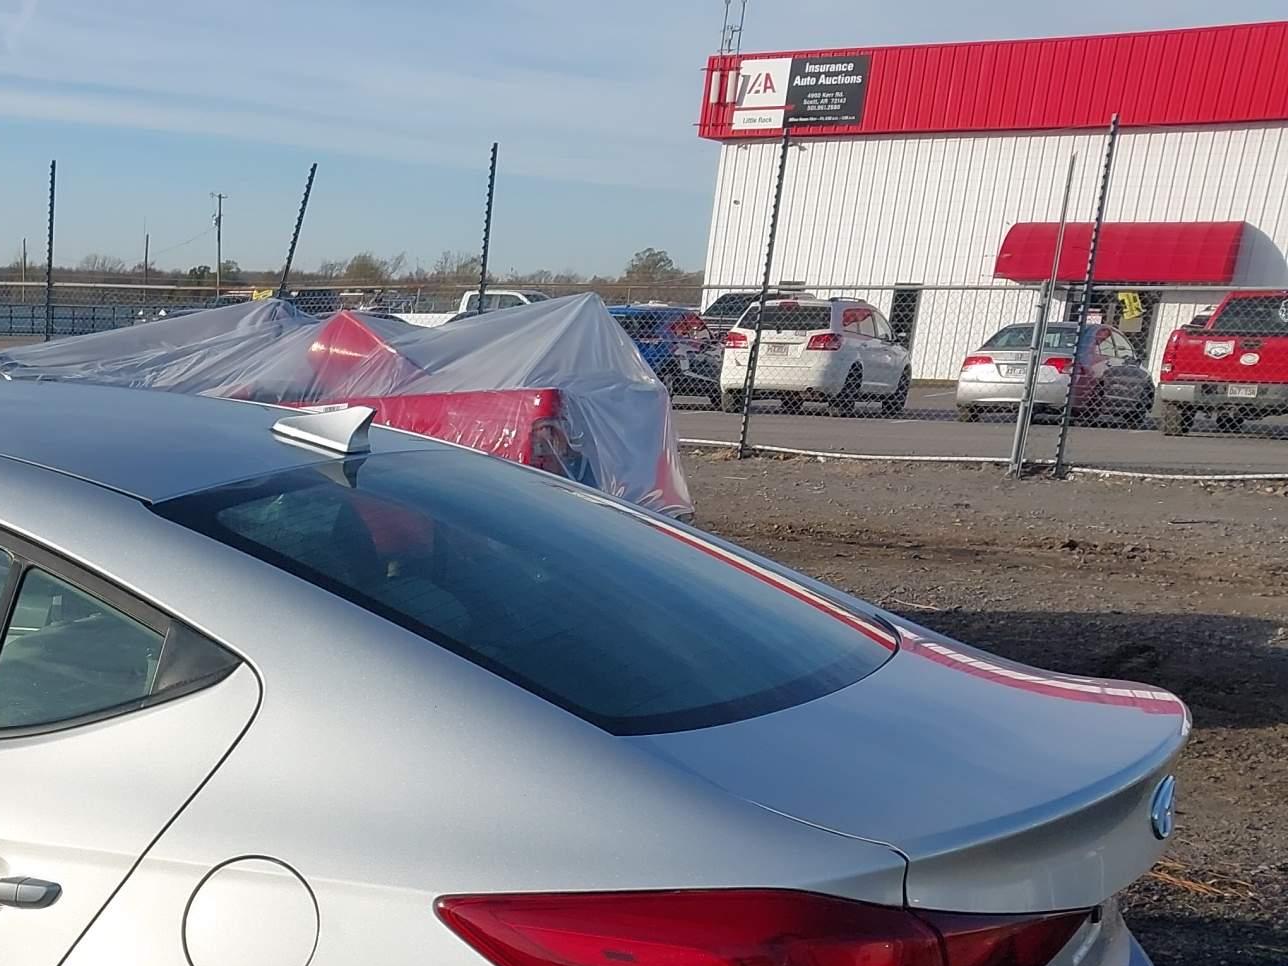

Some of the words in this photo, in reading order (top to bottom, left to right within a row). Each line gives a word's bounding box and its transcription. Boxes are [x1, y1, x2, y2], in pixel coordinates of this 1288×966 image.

[805, 61, 854, 73] Insurance
[793, 75, 816, 86] Auto
[818, 73, 863, 85] Auctions
